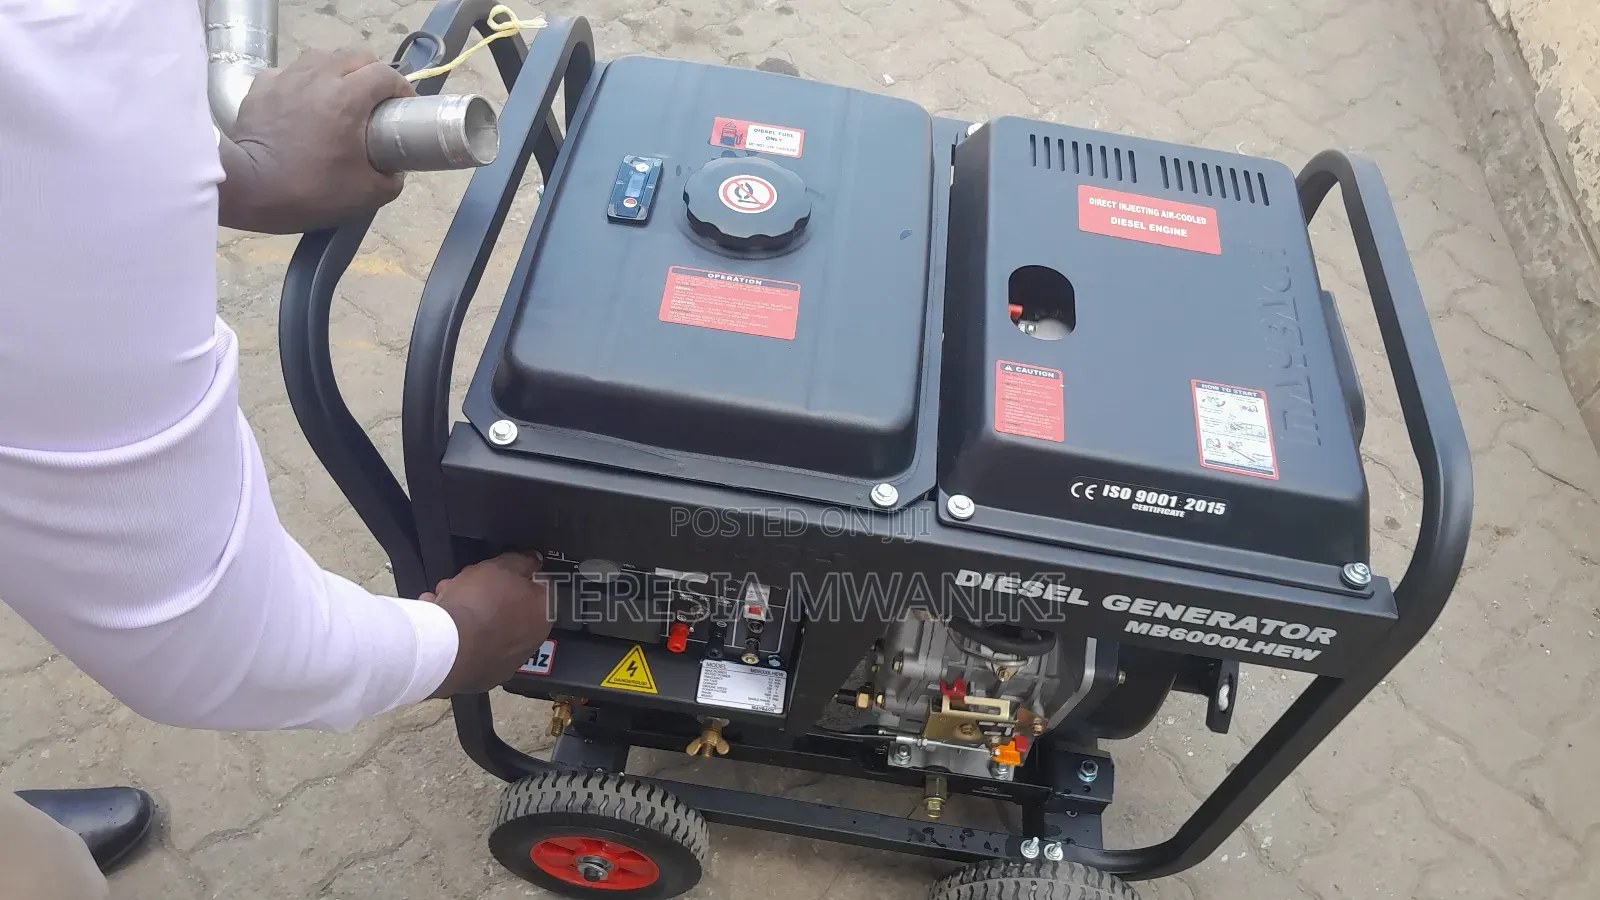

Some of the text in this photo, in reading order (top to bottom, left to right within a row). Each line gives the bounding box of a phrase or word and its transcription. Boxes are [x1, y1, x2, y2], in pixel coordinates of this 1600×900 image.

[1089, 197, 1207, 225] DIRECT INJECTING AIR-COOLED
[1110, 216, 1188, 237] DIESEL ENGINE
[707, 273, 762, 286] OPERATION
[1015, 366, 1055, 378] CAUTION
[1201, 383, 1220, 391] HOW
[1233, 389, 1257, 397] START
[1102, 484, 1132, 500] ISO
[1131, 502, 1186, 518] CERTIFICATE
[954, 568, 1338, 646] DIESEL GENERATOR
[1123, 619, 1323, 663] MB6000LHEW
